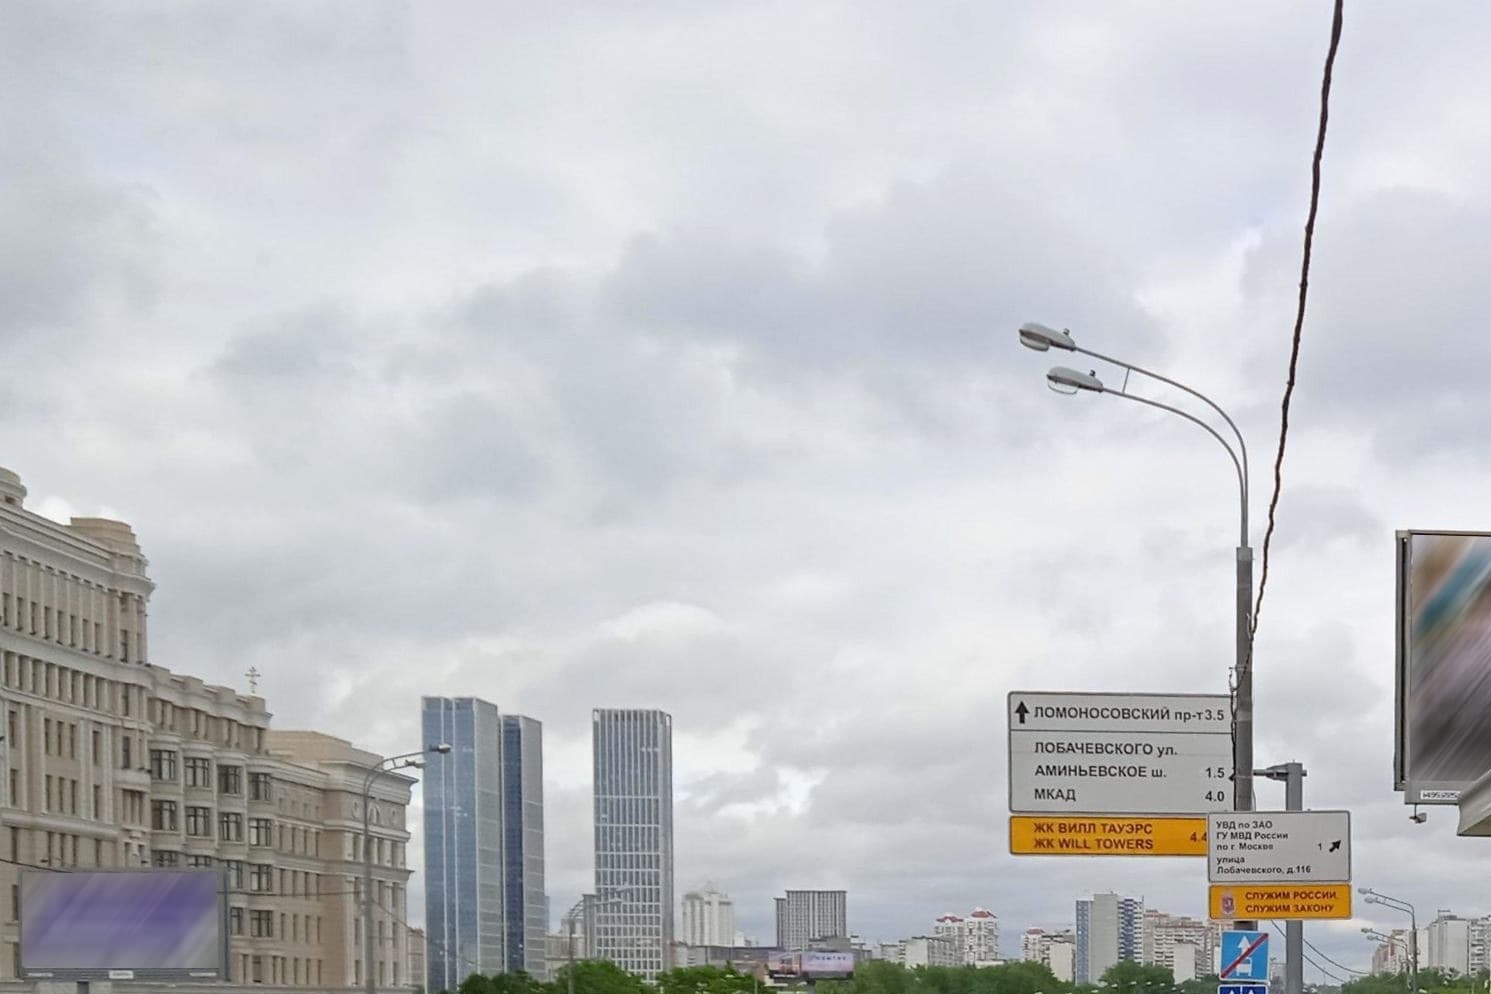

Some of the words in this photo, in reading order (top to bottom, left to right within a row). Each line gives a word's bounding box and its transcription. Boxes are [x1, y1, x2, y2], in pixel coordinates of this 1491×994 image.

[1034, 706, 1170, 721] ЛОМОНОСОВСКИЙ
[1175, 709, 1203, 723] пр-т
[1205, 709, 1224, 721] 3.5
[1034, 742, 1153, 755] ЛОБАЧЕВСКОГО
[1157, 745, 1177, 758] ул.
[1034, 765, 1147, 778] АМИНЬЕВСКОЕ
[1151, 768, 1166, 778] ш.
[1205, 767, 1225, 779] 1.5
[1034, 788, 1076, 801] МКАД
[1205, 791, 1225, 802] 4.0
[1034, 822, 1054, 833] ЖК
[1058, 823, 1096, 834] ВИЛЛ
[1101, 823, 1153, 834] ТАУЭРС
[1216, 821, 1236, 830] УВД
[1252, 821, 1273, 829] ЗАО
[1216, 832, 1228, 840] ГУ
[1230, 832, 1252, 840] МВД
[1254, 832, 1289, 840] России
[1034, 838, 1054, 848] ЖК
[1058, 838, 1091, 849] WILL
[1095, 838, 1153, 850] TOWERS
[1239, 842, 1274, 850] Москве
[1217, 857, 1245, 865] улица
[1245, 891, 1290, 901] СЛУЖИМ
[1293, 891, 1336, 900] РОССИИ
[1245, 904, 1290, 913] СЛУЖИМ
[1293, 904, 1335, 913] ЗАКОНУ
